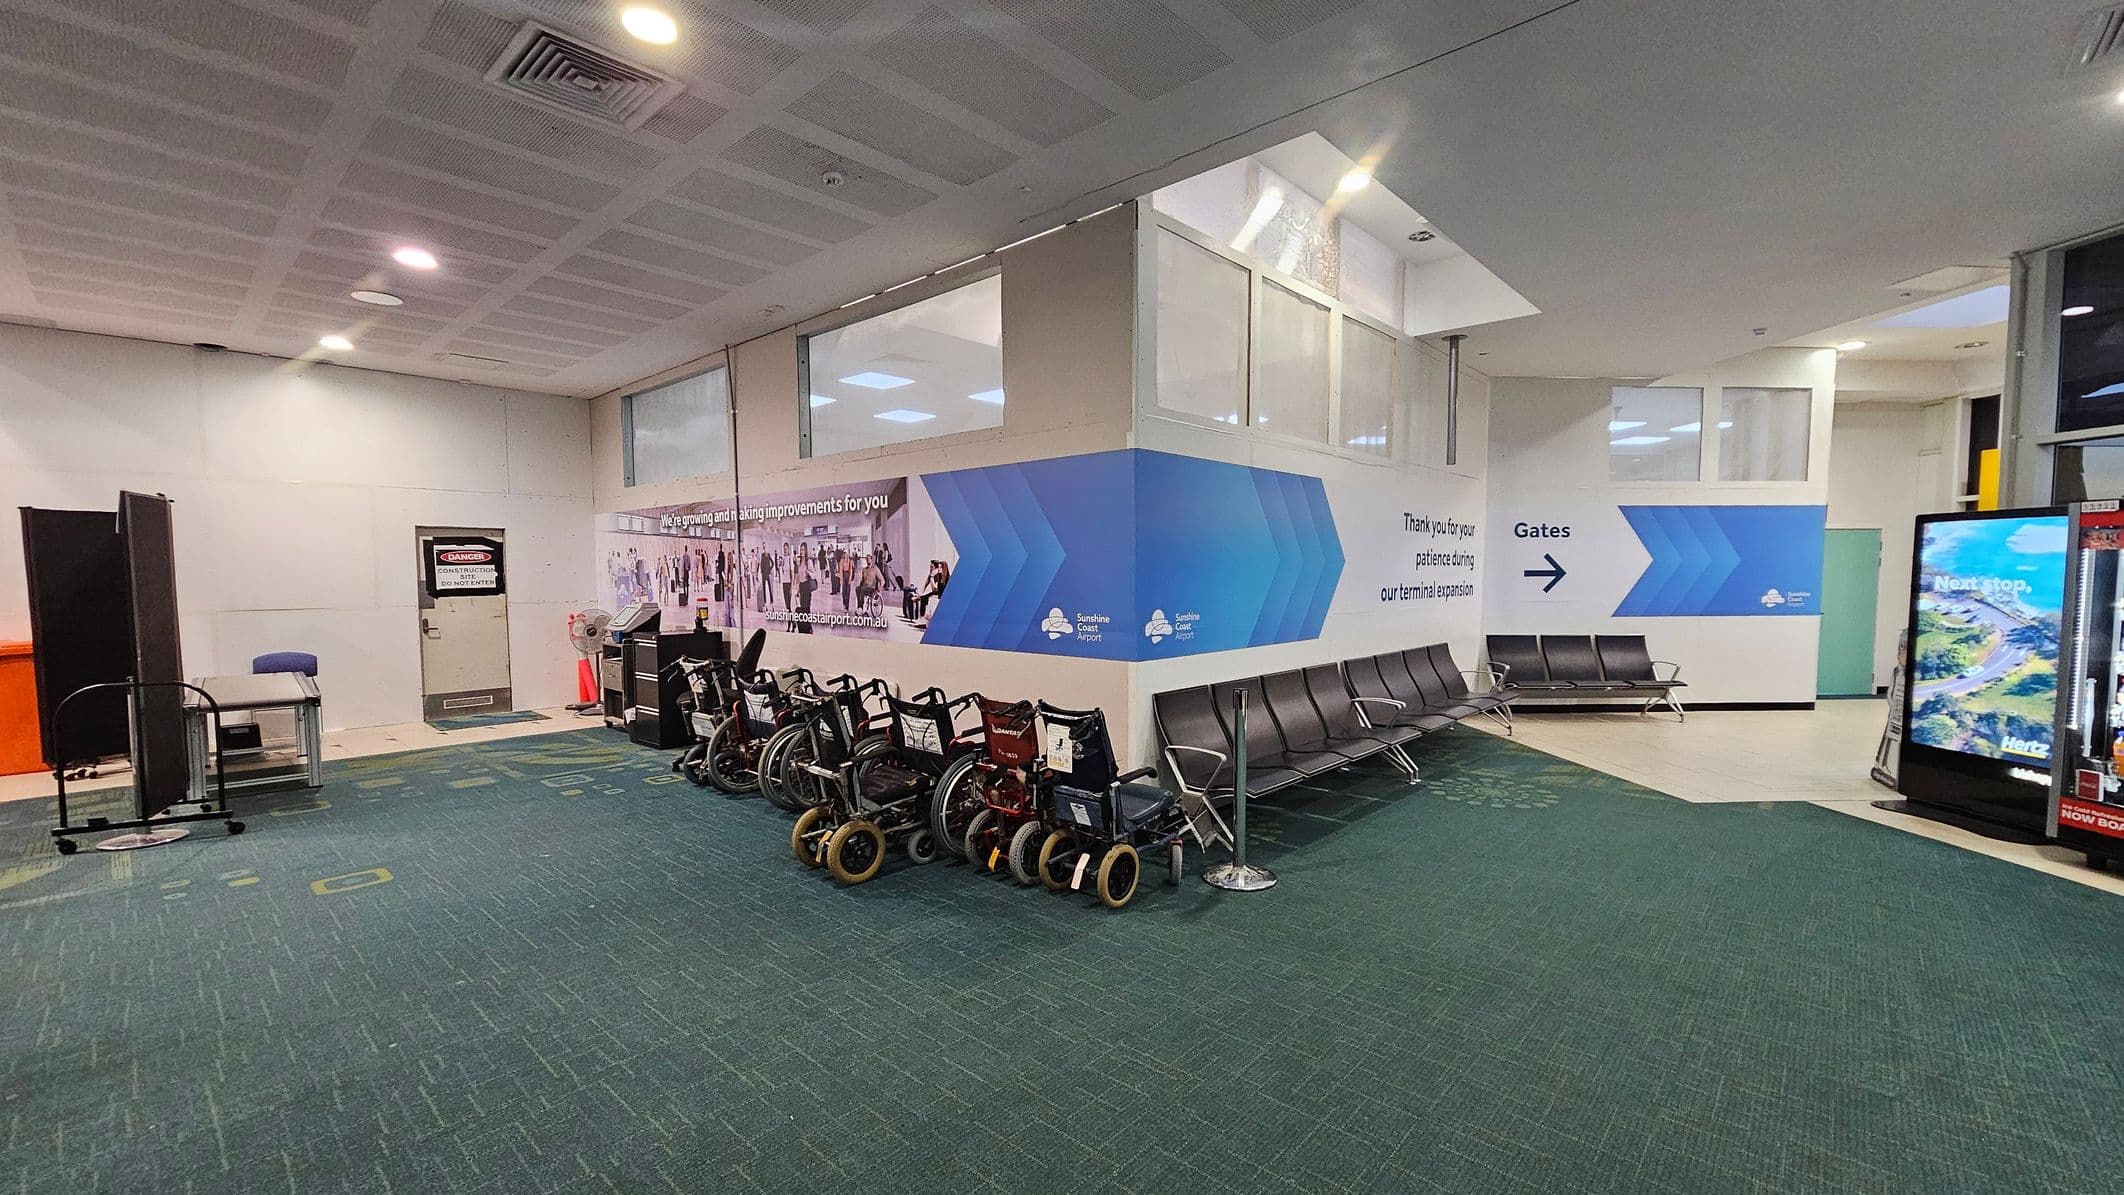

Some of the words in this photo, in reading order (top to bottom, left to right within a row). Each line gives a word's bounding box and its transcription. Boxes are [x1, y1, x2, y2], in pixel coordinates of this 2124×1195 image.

[660, 512, 681, 527] We're
[682, 510, 713, 529] growing
[714, 508, 730, 523] and
[765, 497, 843, 521] improvements
[844, 494, 862, 512] for
[863, 494, 889, 515] you
[1403, 512, 1430, 533] Thank
[1431, 520, 1447, 538] you
[1447, 517, 1458, 535] for
[1459, 523, 1475, 541] your
[1514, 522, 1571, 538] Gates
[447, 553, 485, 561] DANGER
[1415, 548, 1451, 571] patience
[1452, 549, 1475, 571] during
[1381, 586, 1398, 602] our
[1399, 580, 1436, 601] terminal
[1437, 580, 1474, 602] expansion
[1934, 575, 1978, 593] Next
[1980, 577, 2033, 600] stop,
[765, 608, 888, 628] sunshinecoastairport.com.au
[1076, 613, 1110, 624] Sunshine
[1175, 613, 1201, 622] Sunshine
[1076, 623, 1099, 633] Coast
[1175, 623, 1193, 631] Coast
[1076, 632, 1103, 643] Airport
[2001, 735, 2051, 756] Hertz
[2061, 809, 2096, 825] NOW
